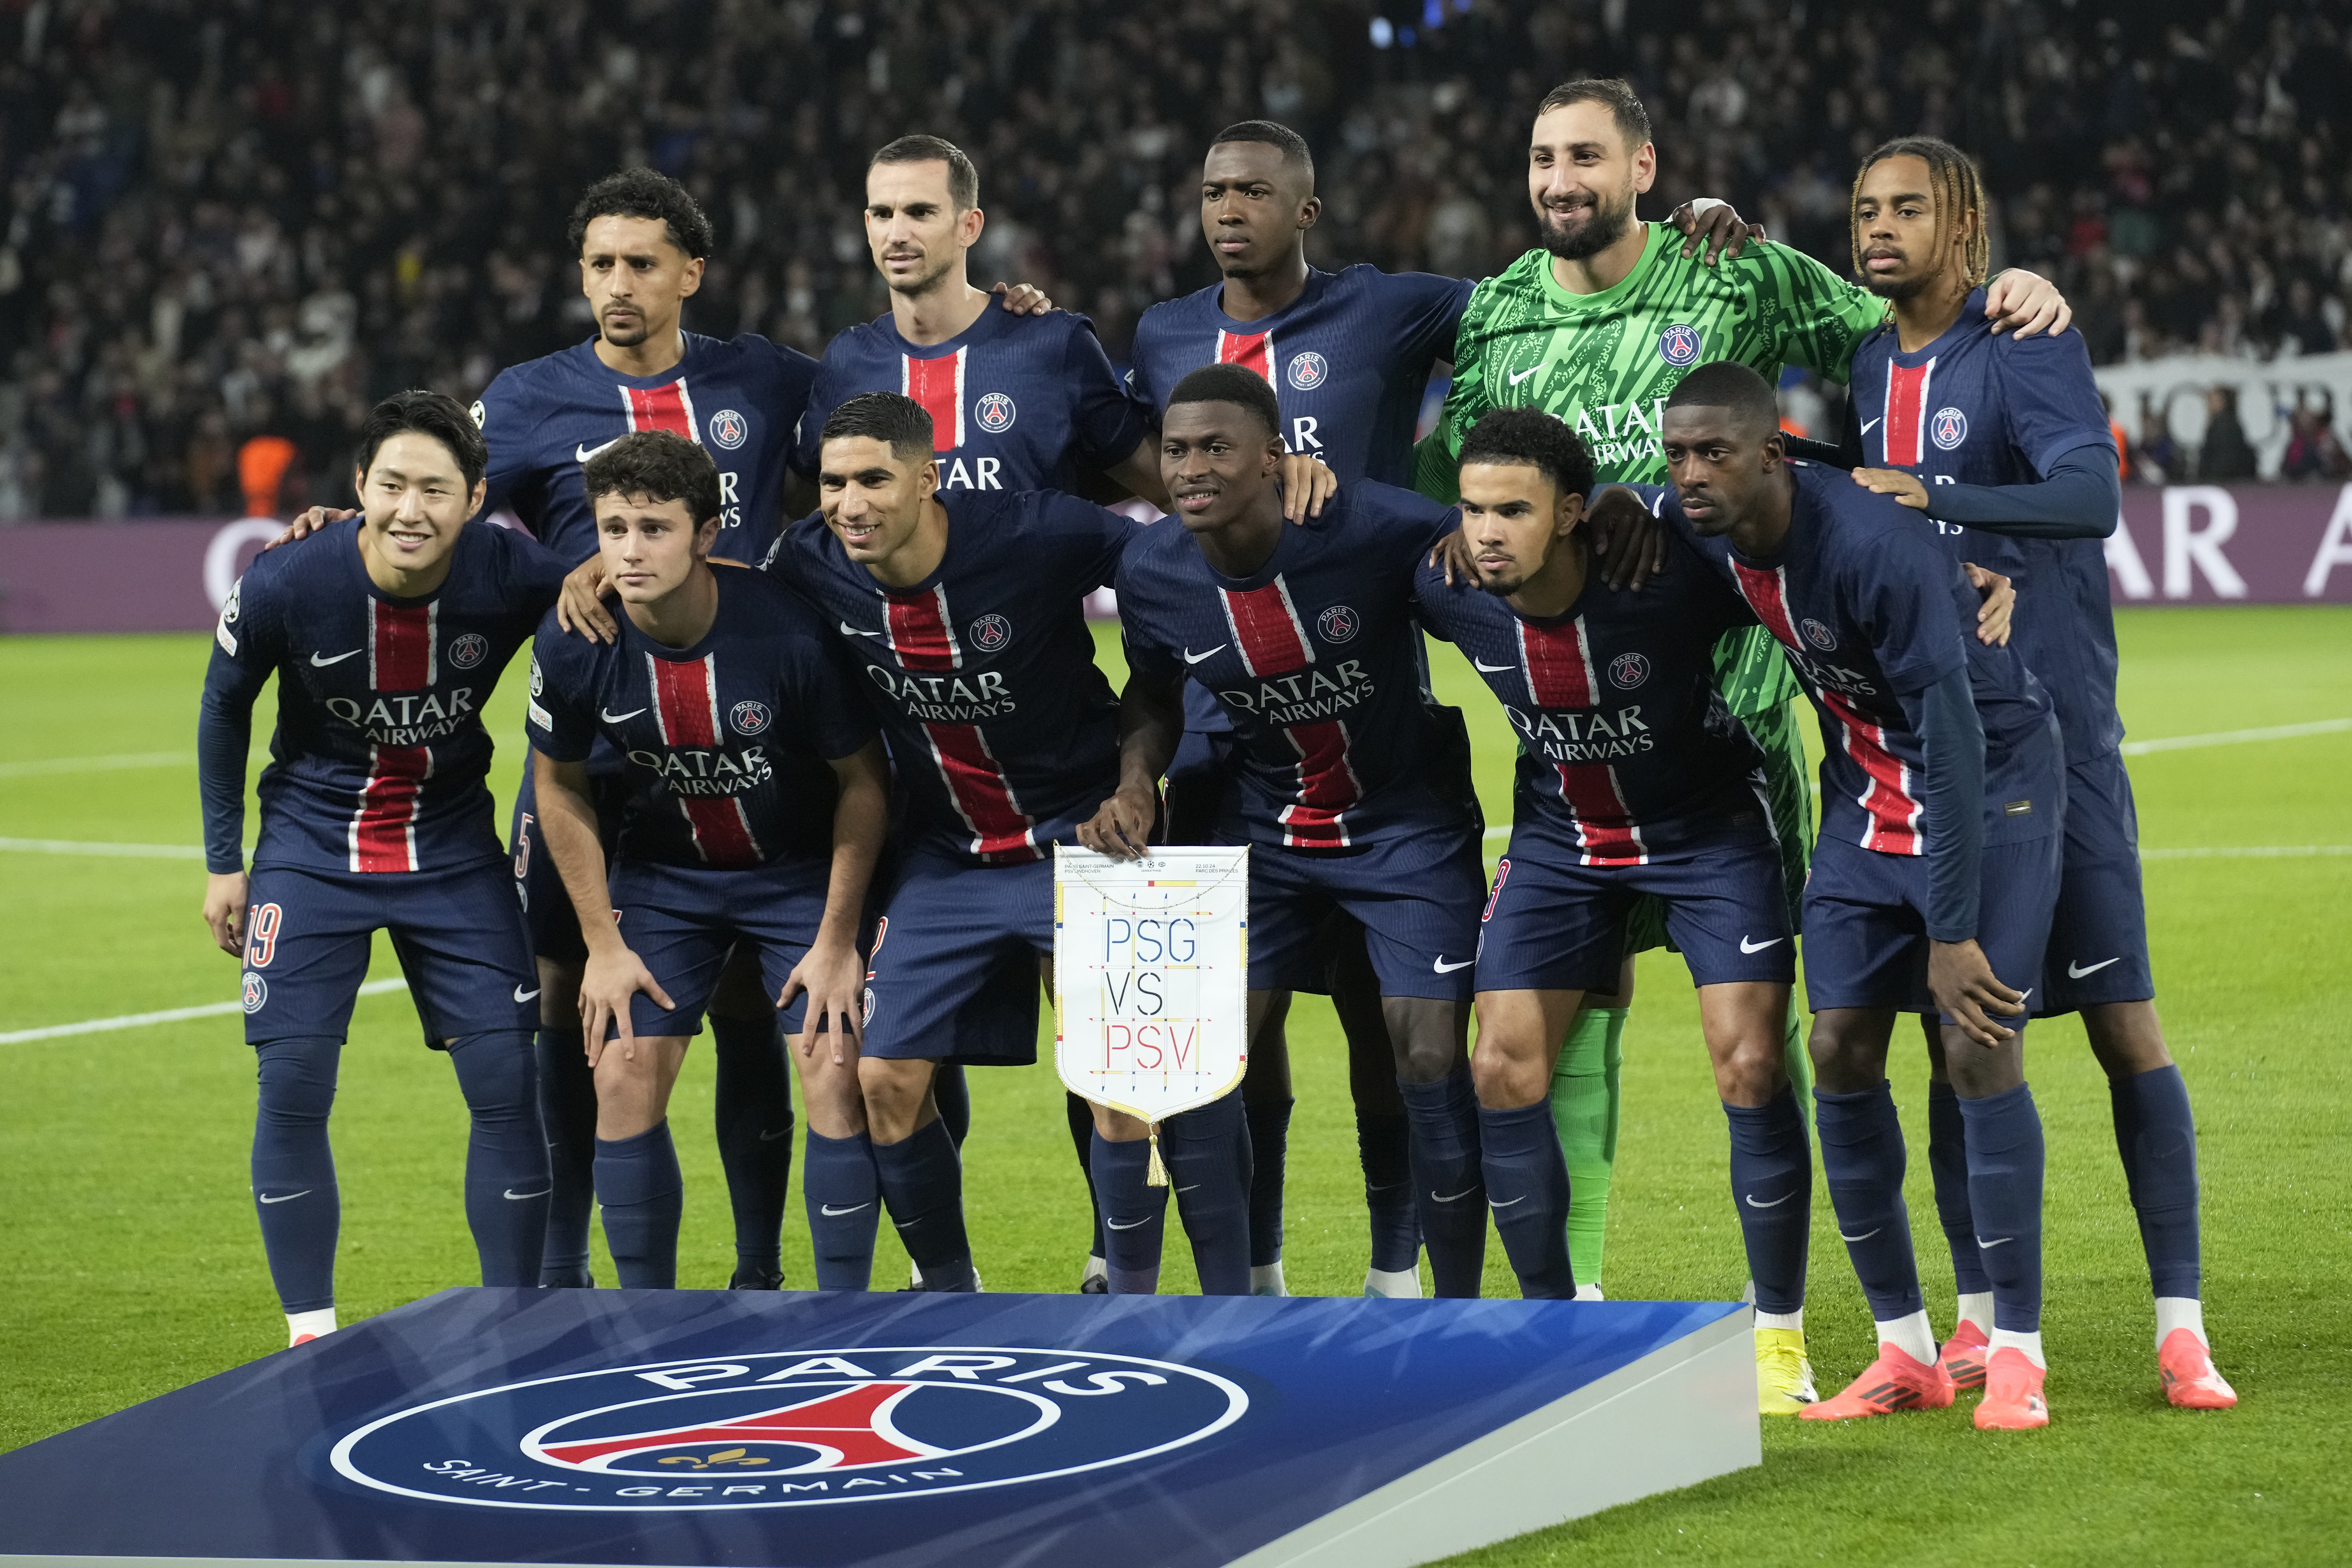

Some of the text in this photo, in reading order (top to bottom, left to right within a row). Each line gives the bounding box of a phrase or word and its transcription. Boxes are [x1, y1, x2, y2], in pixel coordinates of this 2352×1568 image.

[1664, 327, 1691, 339] PARIS
[1294, 354, 1320, 366] PARIS
[982, 395, 1009, 405] PARIS
[714, 412, 738, 423] PARIS
[974, 616, 1001, 628] PARIS
[1321, 608, 1346, 621] PARIS
[456, 635, 482, 645] PARIS
[1613, 655, 1640, 667] PARIS
[867, 665, 1011, 703] QATAR
[1219, 659, 1369, 714] QATAR
[326, 687, 474, 727] QATAR
[735, 703, 763, 712] PARIS
[908, 697, 1016, 720] AIRWAYS
[1270, 680, 1375, 724] AIRWAYS
[1504, 705, 1649, 740] QATAR
[628, 745, 767, 777] QATAR
[1544, 733, 1654, 761] AIRWAYS
[668, 761, 772, 794] AIRWAYS
[514, 812, 534, 878] 5
[242, 903, 282, 969] 19
[1107, 919, 1195, 962] PSG
[1106, 972, 1163, 1015] VS
[1107, 1025, 1195, 1070] PSV
[633, 1355, 1168, 1395] PARIS
[423, 1460, 567, 1491] SAINT
[616, 1467, 964, 1496] GERMAIN
